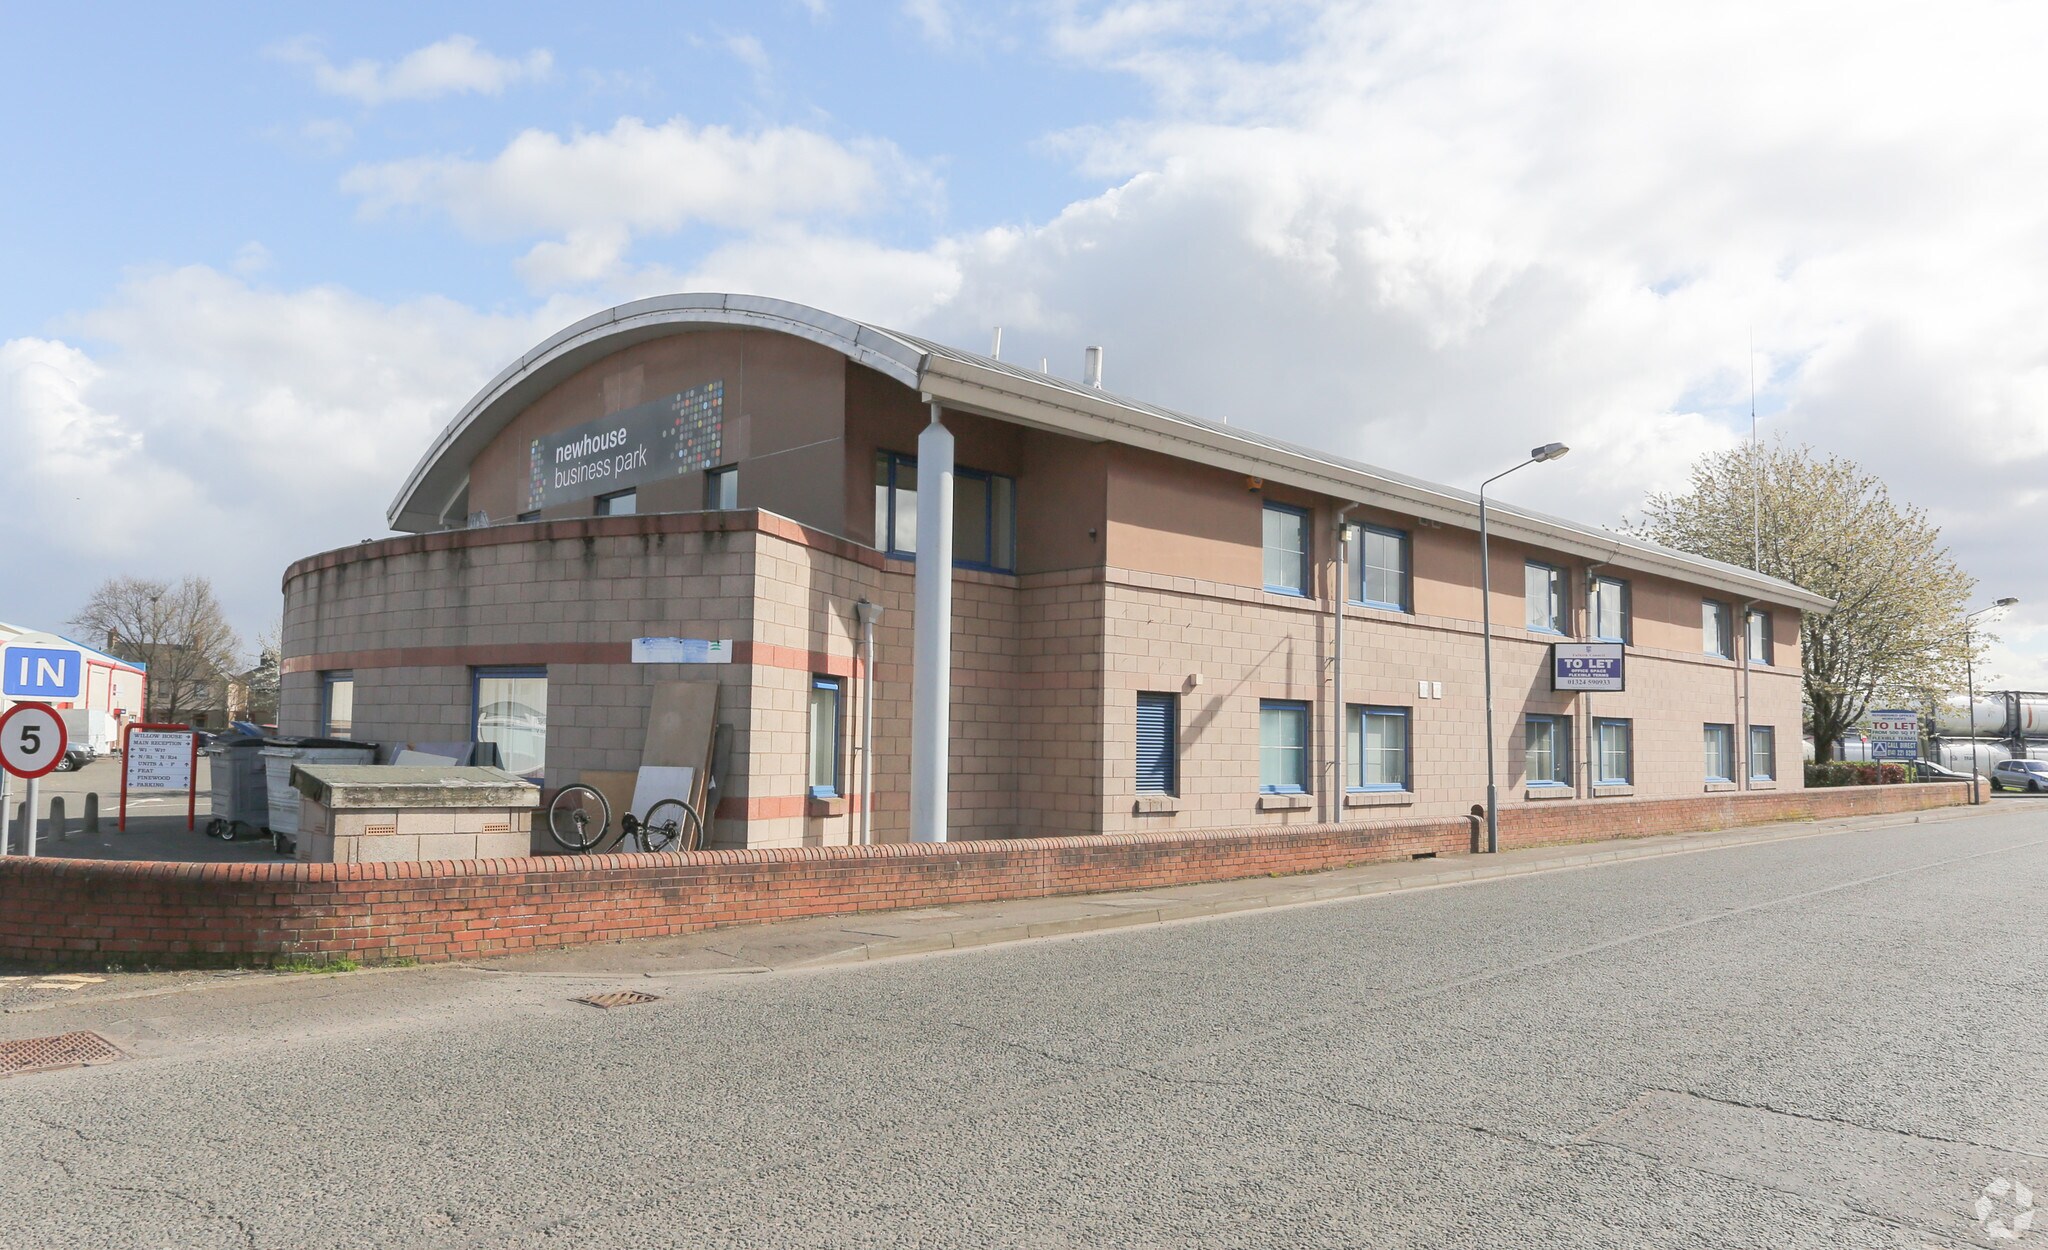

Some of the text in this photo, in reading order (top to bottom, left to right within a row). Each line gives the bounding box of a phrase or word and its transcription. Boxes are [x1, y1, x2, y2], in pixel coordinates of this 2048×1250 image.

[555, 427, 627, 464] newhouse
[554, 443, 647, 489] business park
[20, 657, 65, 687] IN
[1564, 659, 1614, 668] TO LET
[20, 725, 41, 755] 5
[1872, 721, 1916, 730] TO LET
